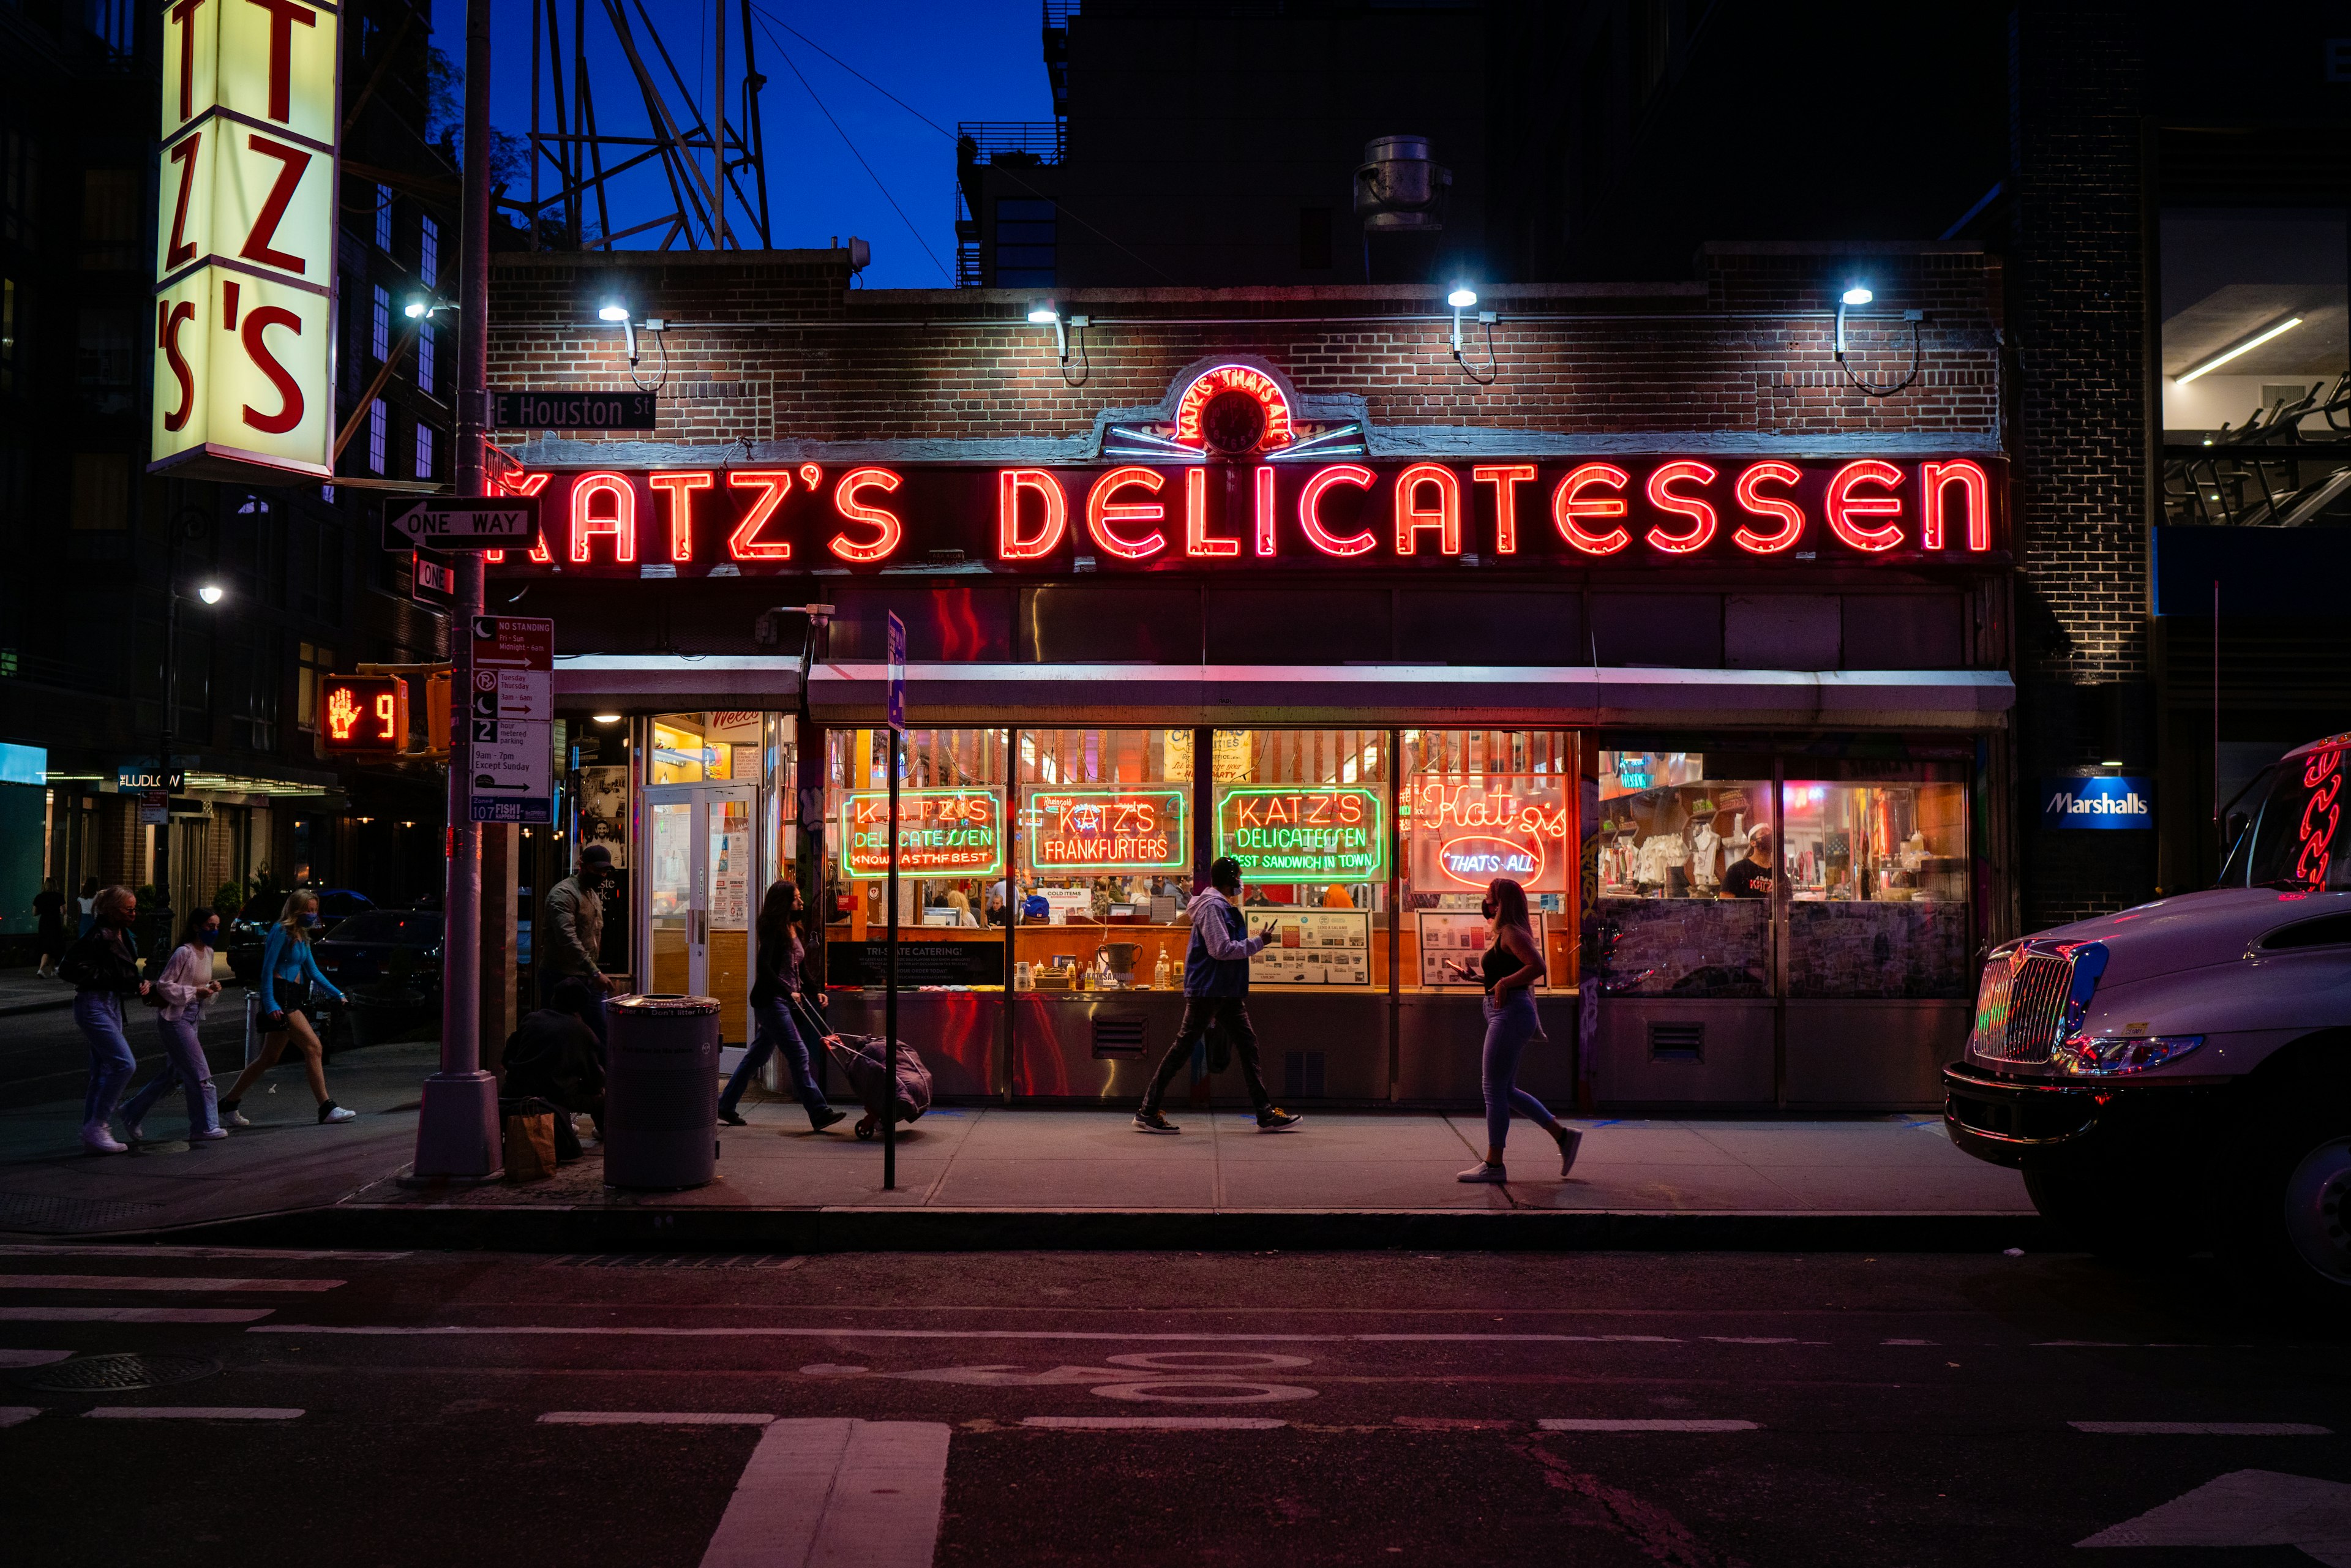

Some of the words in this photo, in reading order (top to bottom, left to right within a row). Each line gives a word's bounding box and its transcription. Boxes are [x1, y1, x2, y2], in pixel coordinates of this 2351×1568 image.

[498, 397, 507, 425] E
[520, 396, 623, 425] Houston
[634, 397, 650, 415] St
[999, 460, 1989, 559] DELICATESSEN
[408, 514, 450, 533] ONE
[473, 514, 519, 533] WAY
[425, 565, 445, 588] ONE
[512, 623, 550, 632] STANDING
[377, 695, 394, 738] 9
[479, 721, 490, 740] 2
[476, 761, 501, 770] Except
[503, 762, 530, 771] Sunday
[474, 806, 495, 819] 107
[1239, 792, 1361, 827] KATZ'S
[2046, 792, 2148, 814] Marshalls
[855, 830, 992, 847] DELCATESSEN
[1237, 828, 1366, 848] DELICATESSEN
[1044, 839, 1168, 860] FRANKFURTERS
[852, 855, 890, 865] KNOW
[1262, 855, 1321, 869] SANDWICH
[1324, 855, 1335, 868] IN
[1338, 854, 1372, 868] TOWN
[598, 879, 615, 888] ste
[866, 947, 910, 956] TRI-SATE
[912, 947, 962, 956] CATERING!
